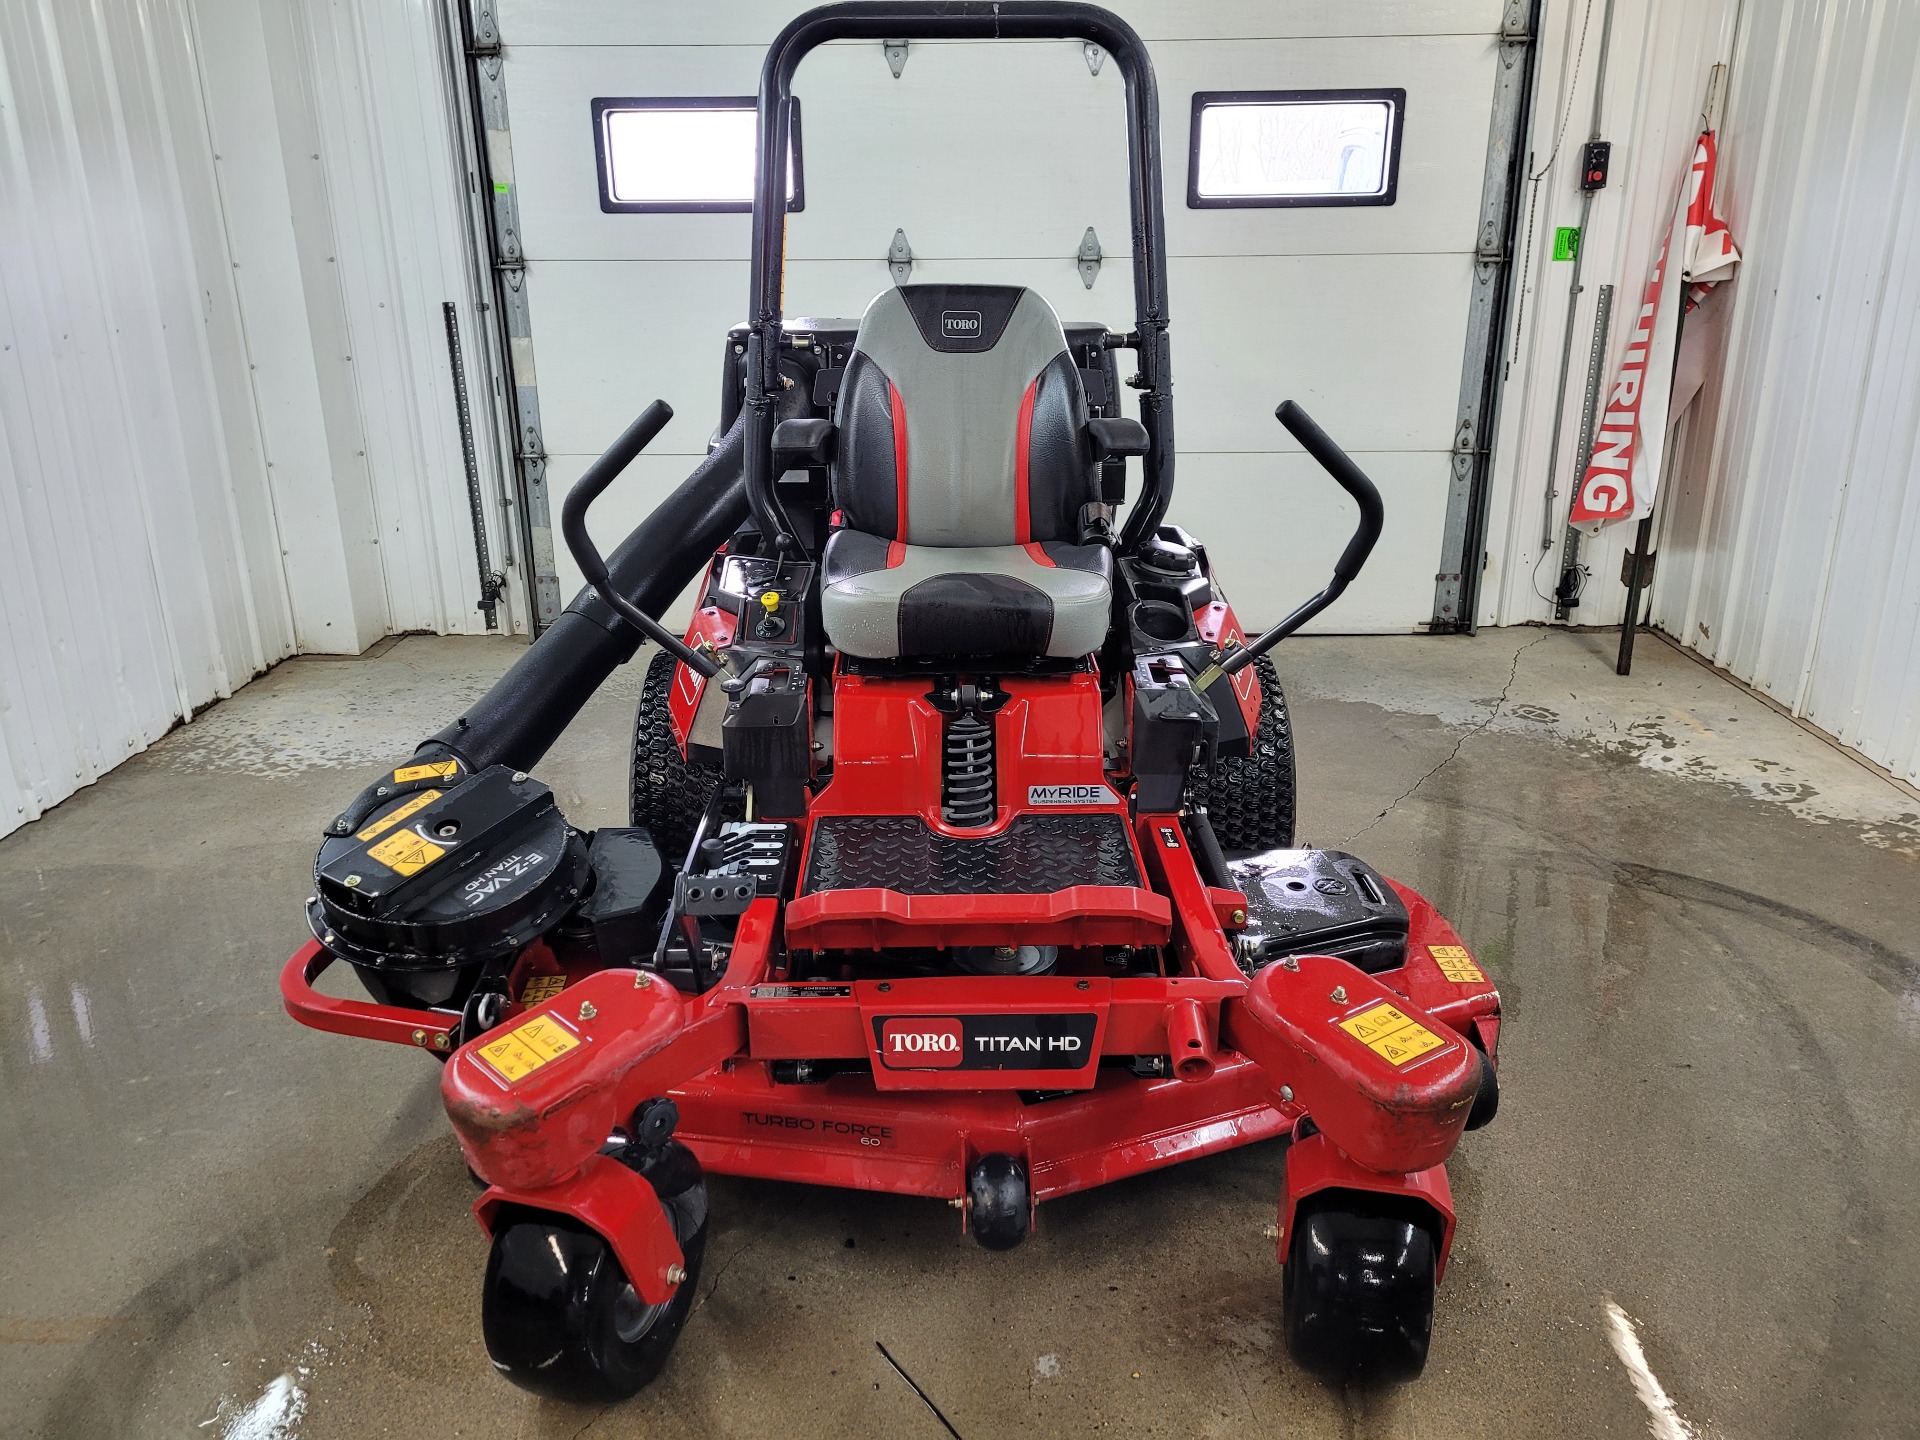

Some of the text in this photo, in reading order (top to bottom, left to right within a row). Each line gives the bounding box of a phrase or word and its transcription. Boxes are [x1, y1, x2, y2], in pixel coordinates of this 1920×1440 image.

[944, 318, 978, 330] TORO
[464, 854, 523, 891] TITAN HD
[464, 852, 544, 905] E-Z VAC
[889, 1032, 1081, 1052] TORO TITAN HD
[742, 1111, 892, 1138] TURBO FORCE
[860, 1136, 881, 1147] 60
